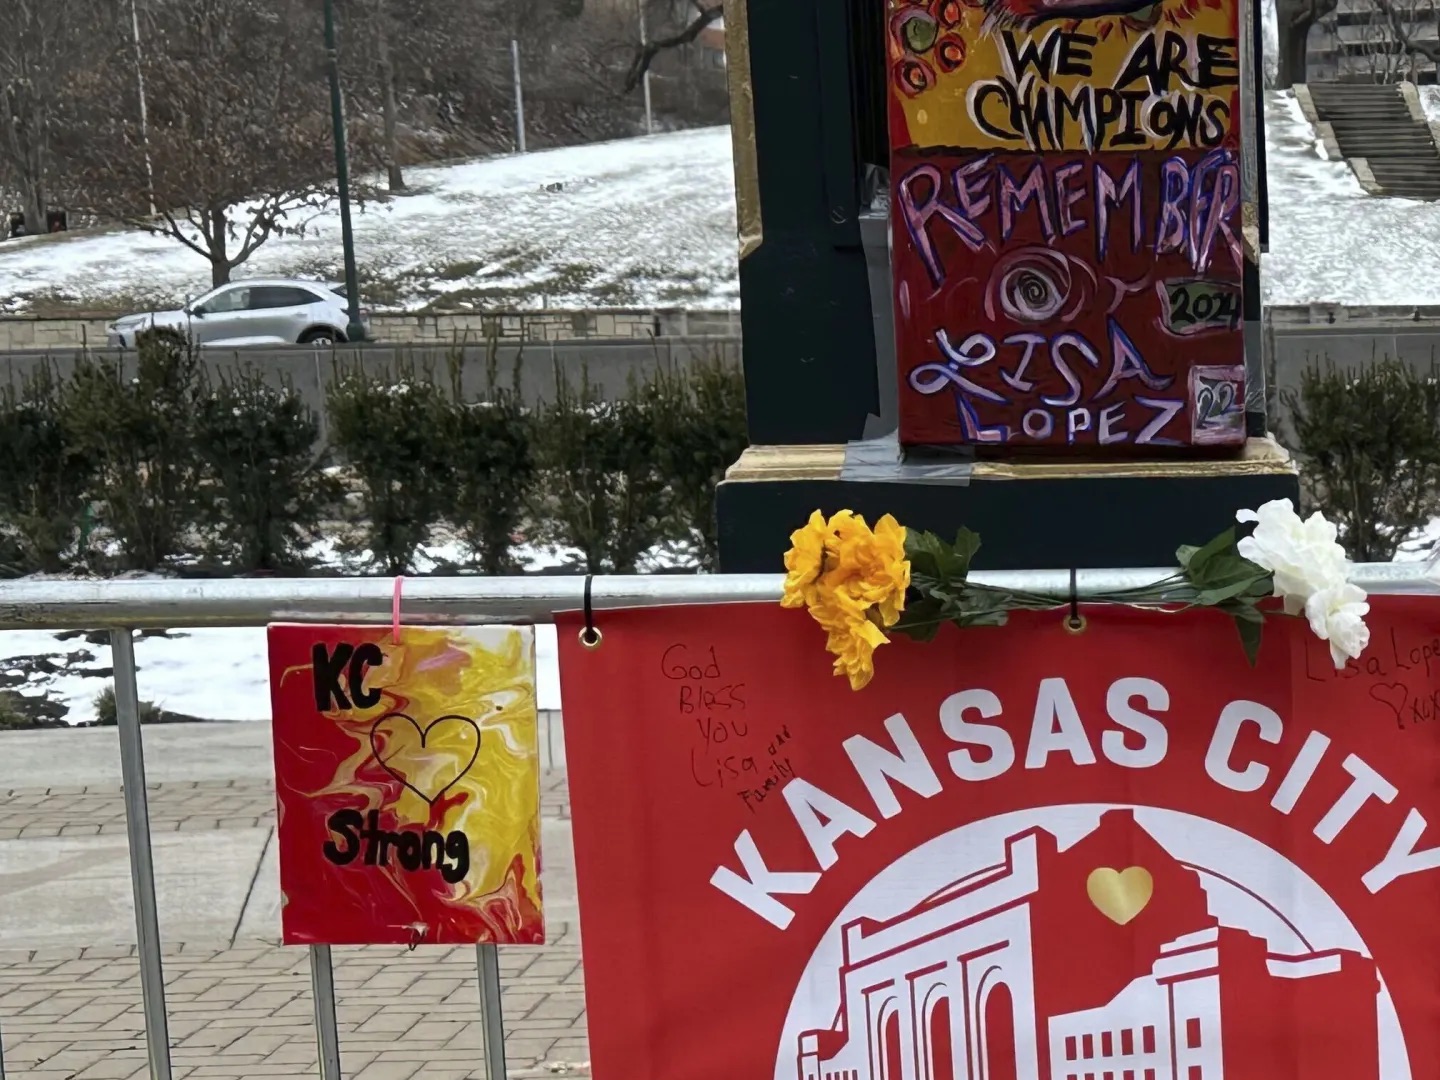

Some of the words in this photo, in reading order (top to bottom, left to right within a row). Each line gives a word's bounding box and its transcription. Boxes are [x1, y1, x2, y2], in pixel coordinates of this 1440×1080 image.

[1000, 26, 1098, 82] WE
[1113, 30, 1240, 95] ARE
[968, 75, 1230, 154] CHAMPIONS
[900, 150, 1243, 286] REMEMBER
[1170, 287, 1241, 331] 2024
[909, 316, 1175, 407] LISA
[957, 394, 1189, 446] LOPEZ
[1197, 382, 1245, 430] 22
[311, 642, 383, 712] KC
[661, 643, 721, 681] God
[710, 677, 1170, 931] KANSAS
[322, 808, 470, 884] Strong
